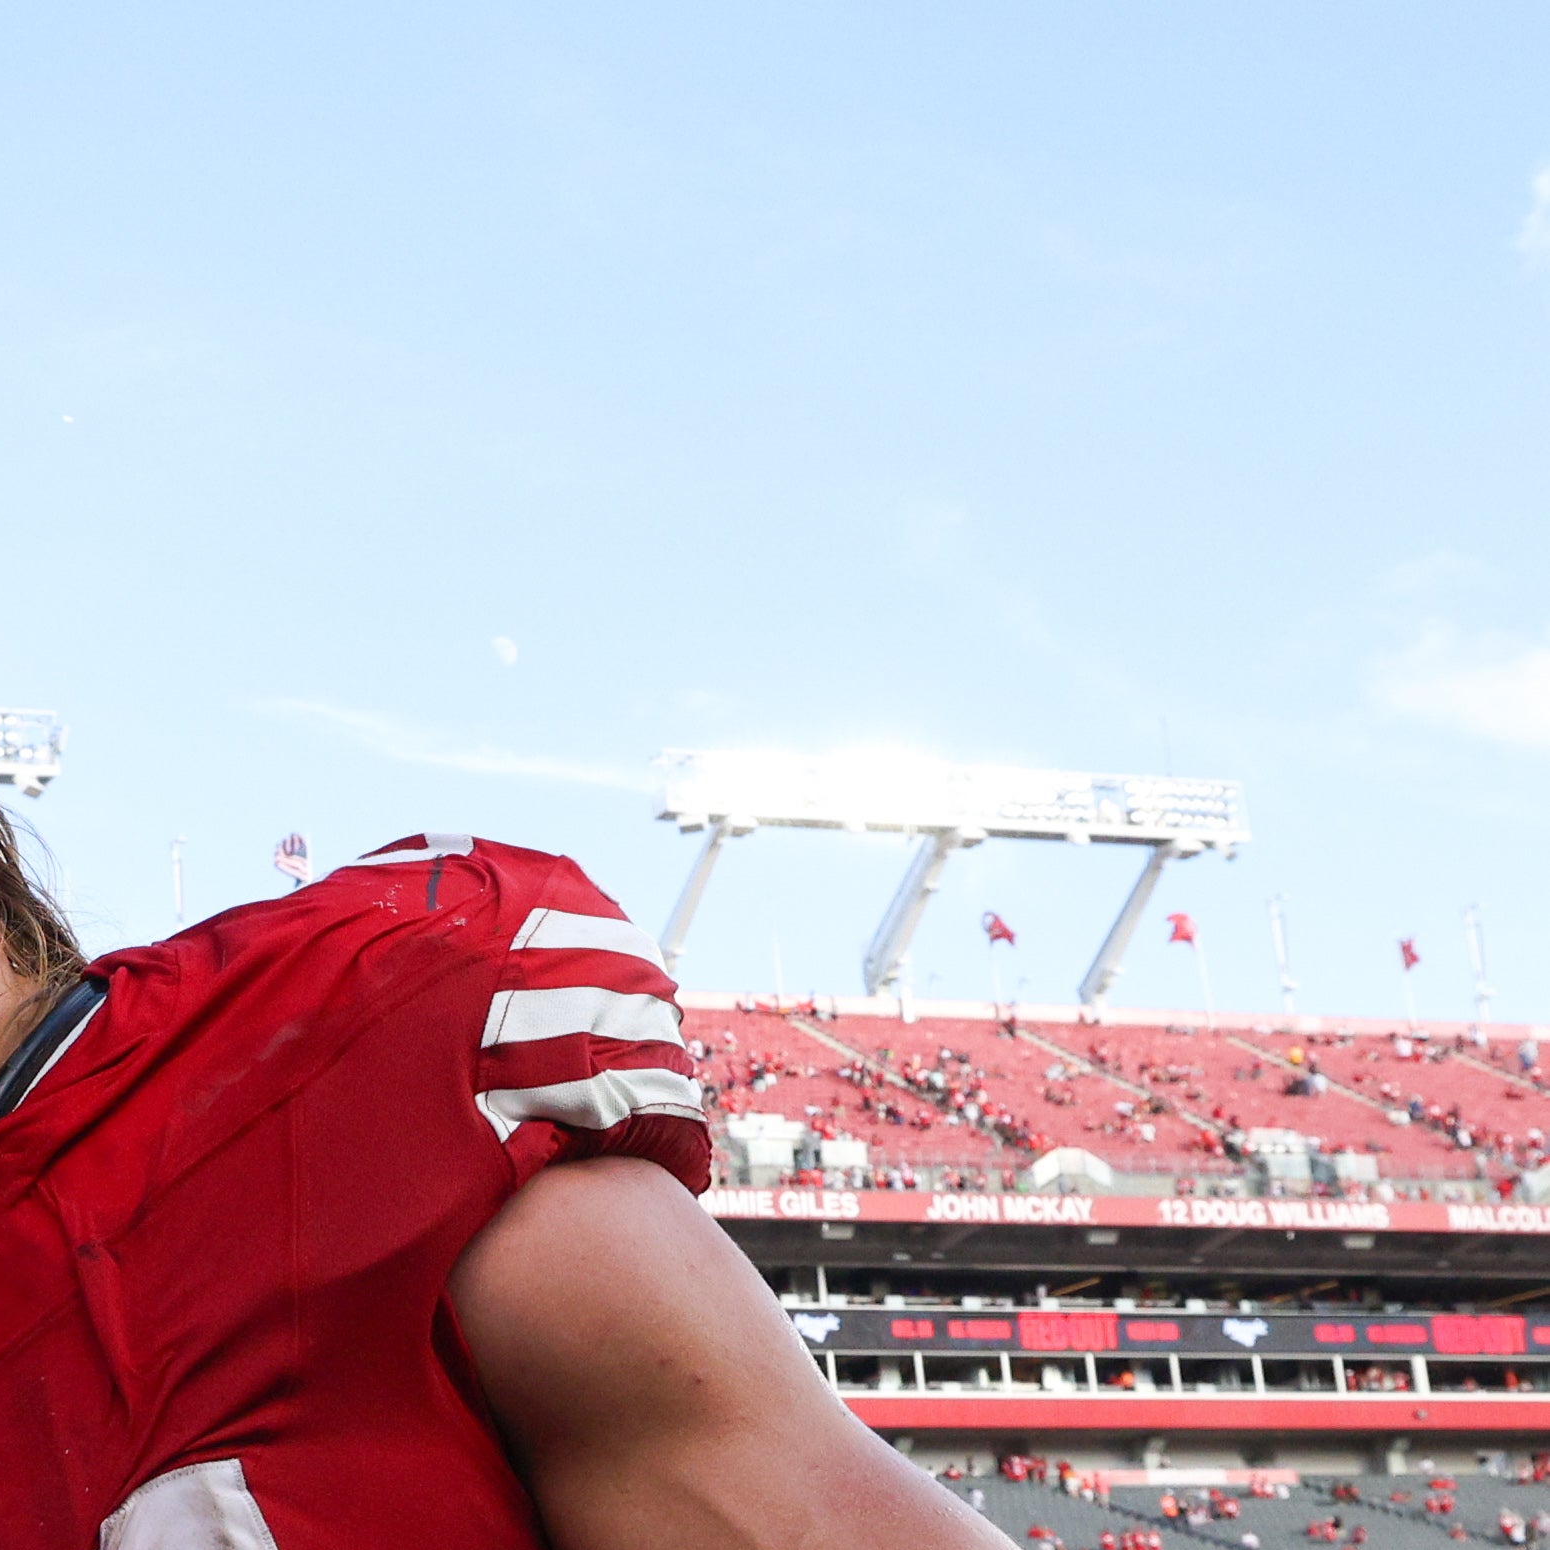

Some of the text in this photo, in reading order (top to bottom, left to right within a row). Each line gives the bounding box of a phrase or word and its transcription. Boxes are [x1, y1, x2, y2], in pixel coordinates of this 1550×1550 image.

[778, 1190, 861, 1218] GILES
[926, 1193, 1093, 1222] JOHN MCKAY
[1157, 1199, 1390, 1229] 12 DOUG WILLIAMS
[1446, 1203, 1550, 1232] MALCOL
